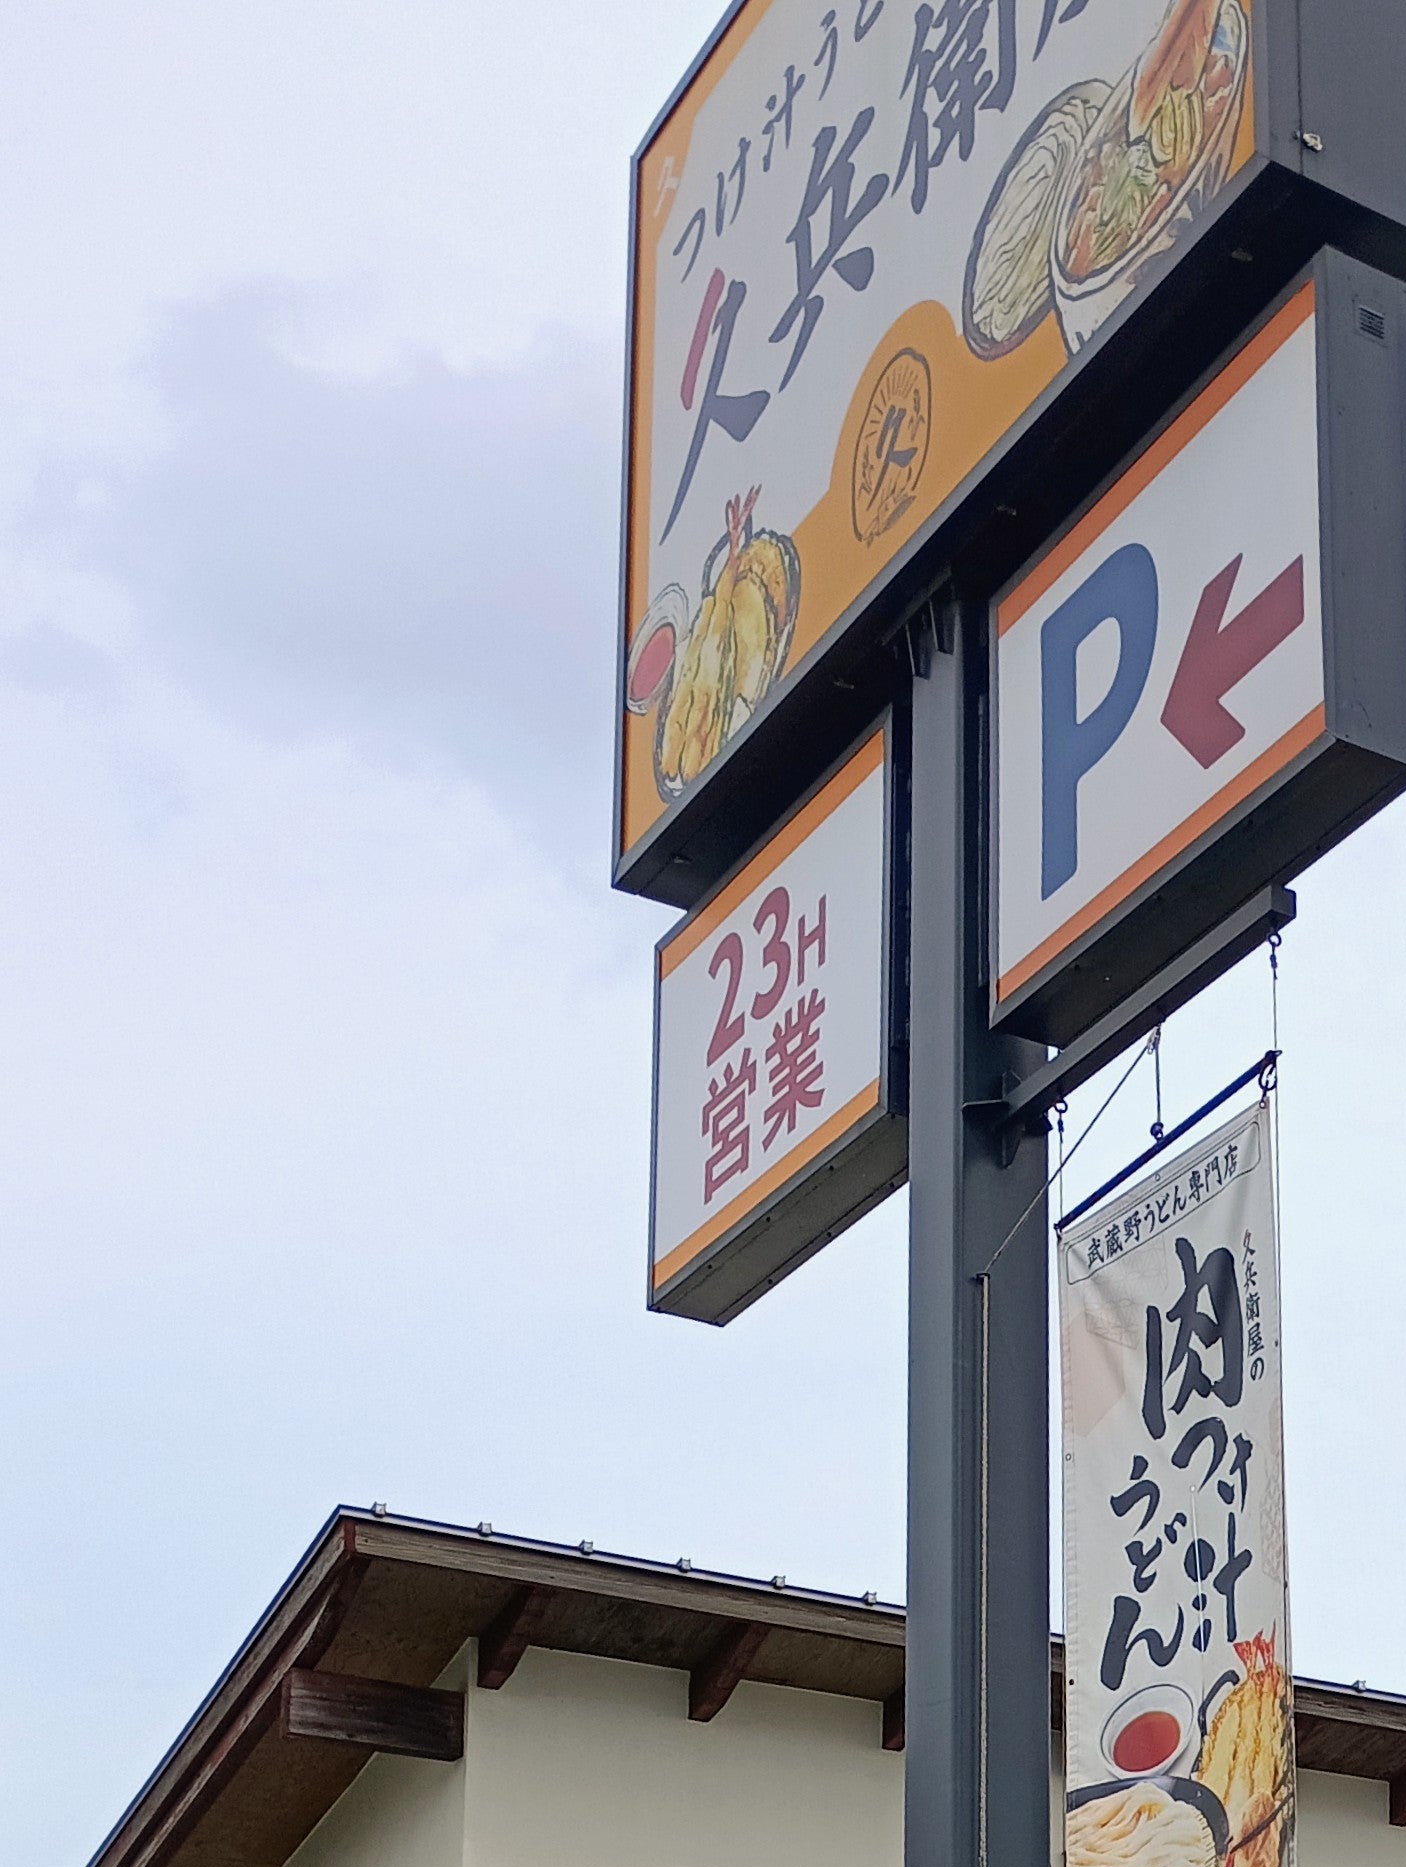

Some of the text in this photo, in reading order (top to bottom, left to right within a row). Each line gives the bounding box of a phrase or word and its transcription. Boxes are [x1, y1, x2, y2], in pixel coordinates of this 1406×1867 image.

[660, 0, 1090, 546] 久兵衛
[1041, 543, 1159, 900] P
[705, 885, 827, 1068] 23H
[702, 987, 827, 1206] 営業
[1086, 1143, 1239, 1270] 武蔵野うどん専門店
[1242, 1229, 1265, 1382] 久兵衛屋の
[1100, 1454, 1188, 1692] うどん
